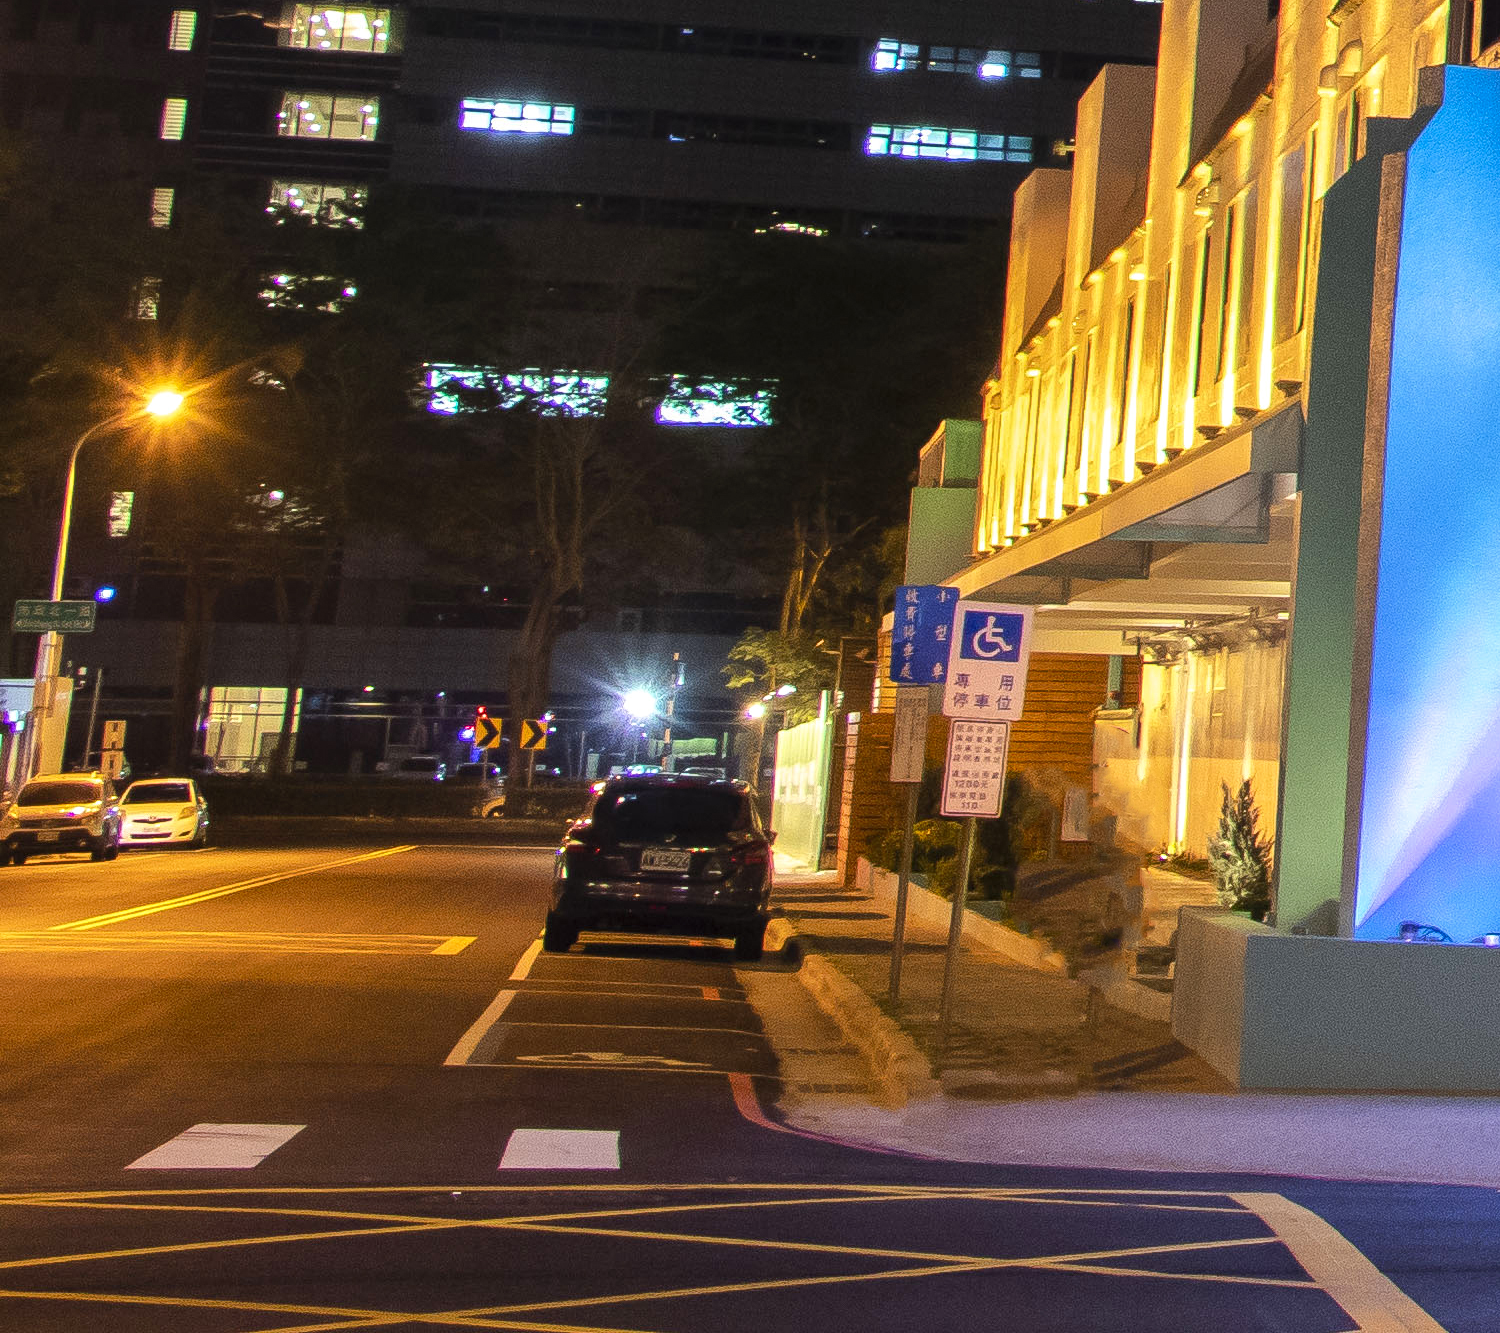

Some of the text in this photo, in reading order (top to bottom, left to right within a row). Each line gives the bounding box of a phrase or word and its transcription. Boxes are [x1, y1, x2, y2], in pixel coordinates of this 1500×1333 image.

[954, 673, 1014, 692] 專用
[953, 692, 1013, 711] 停車位
